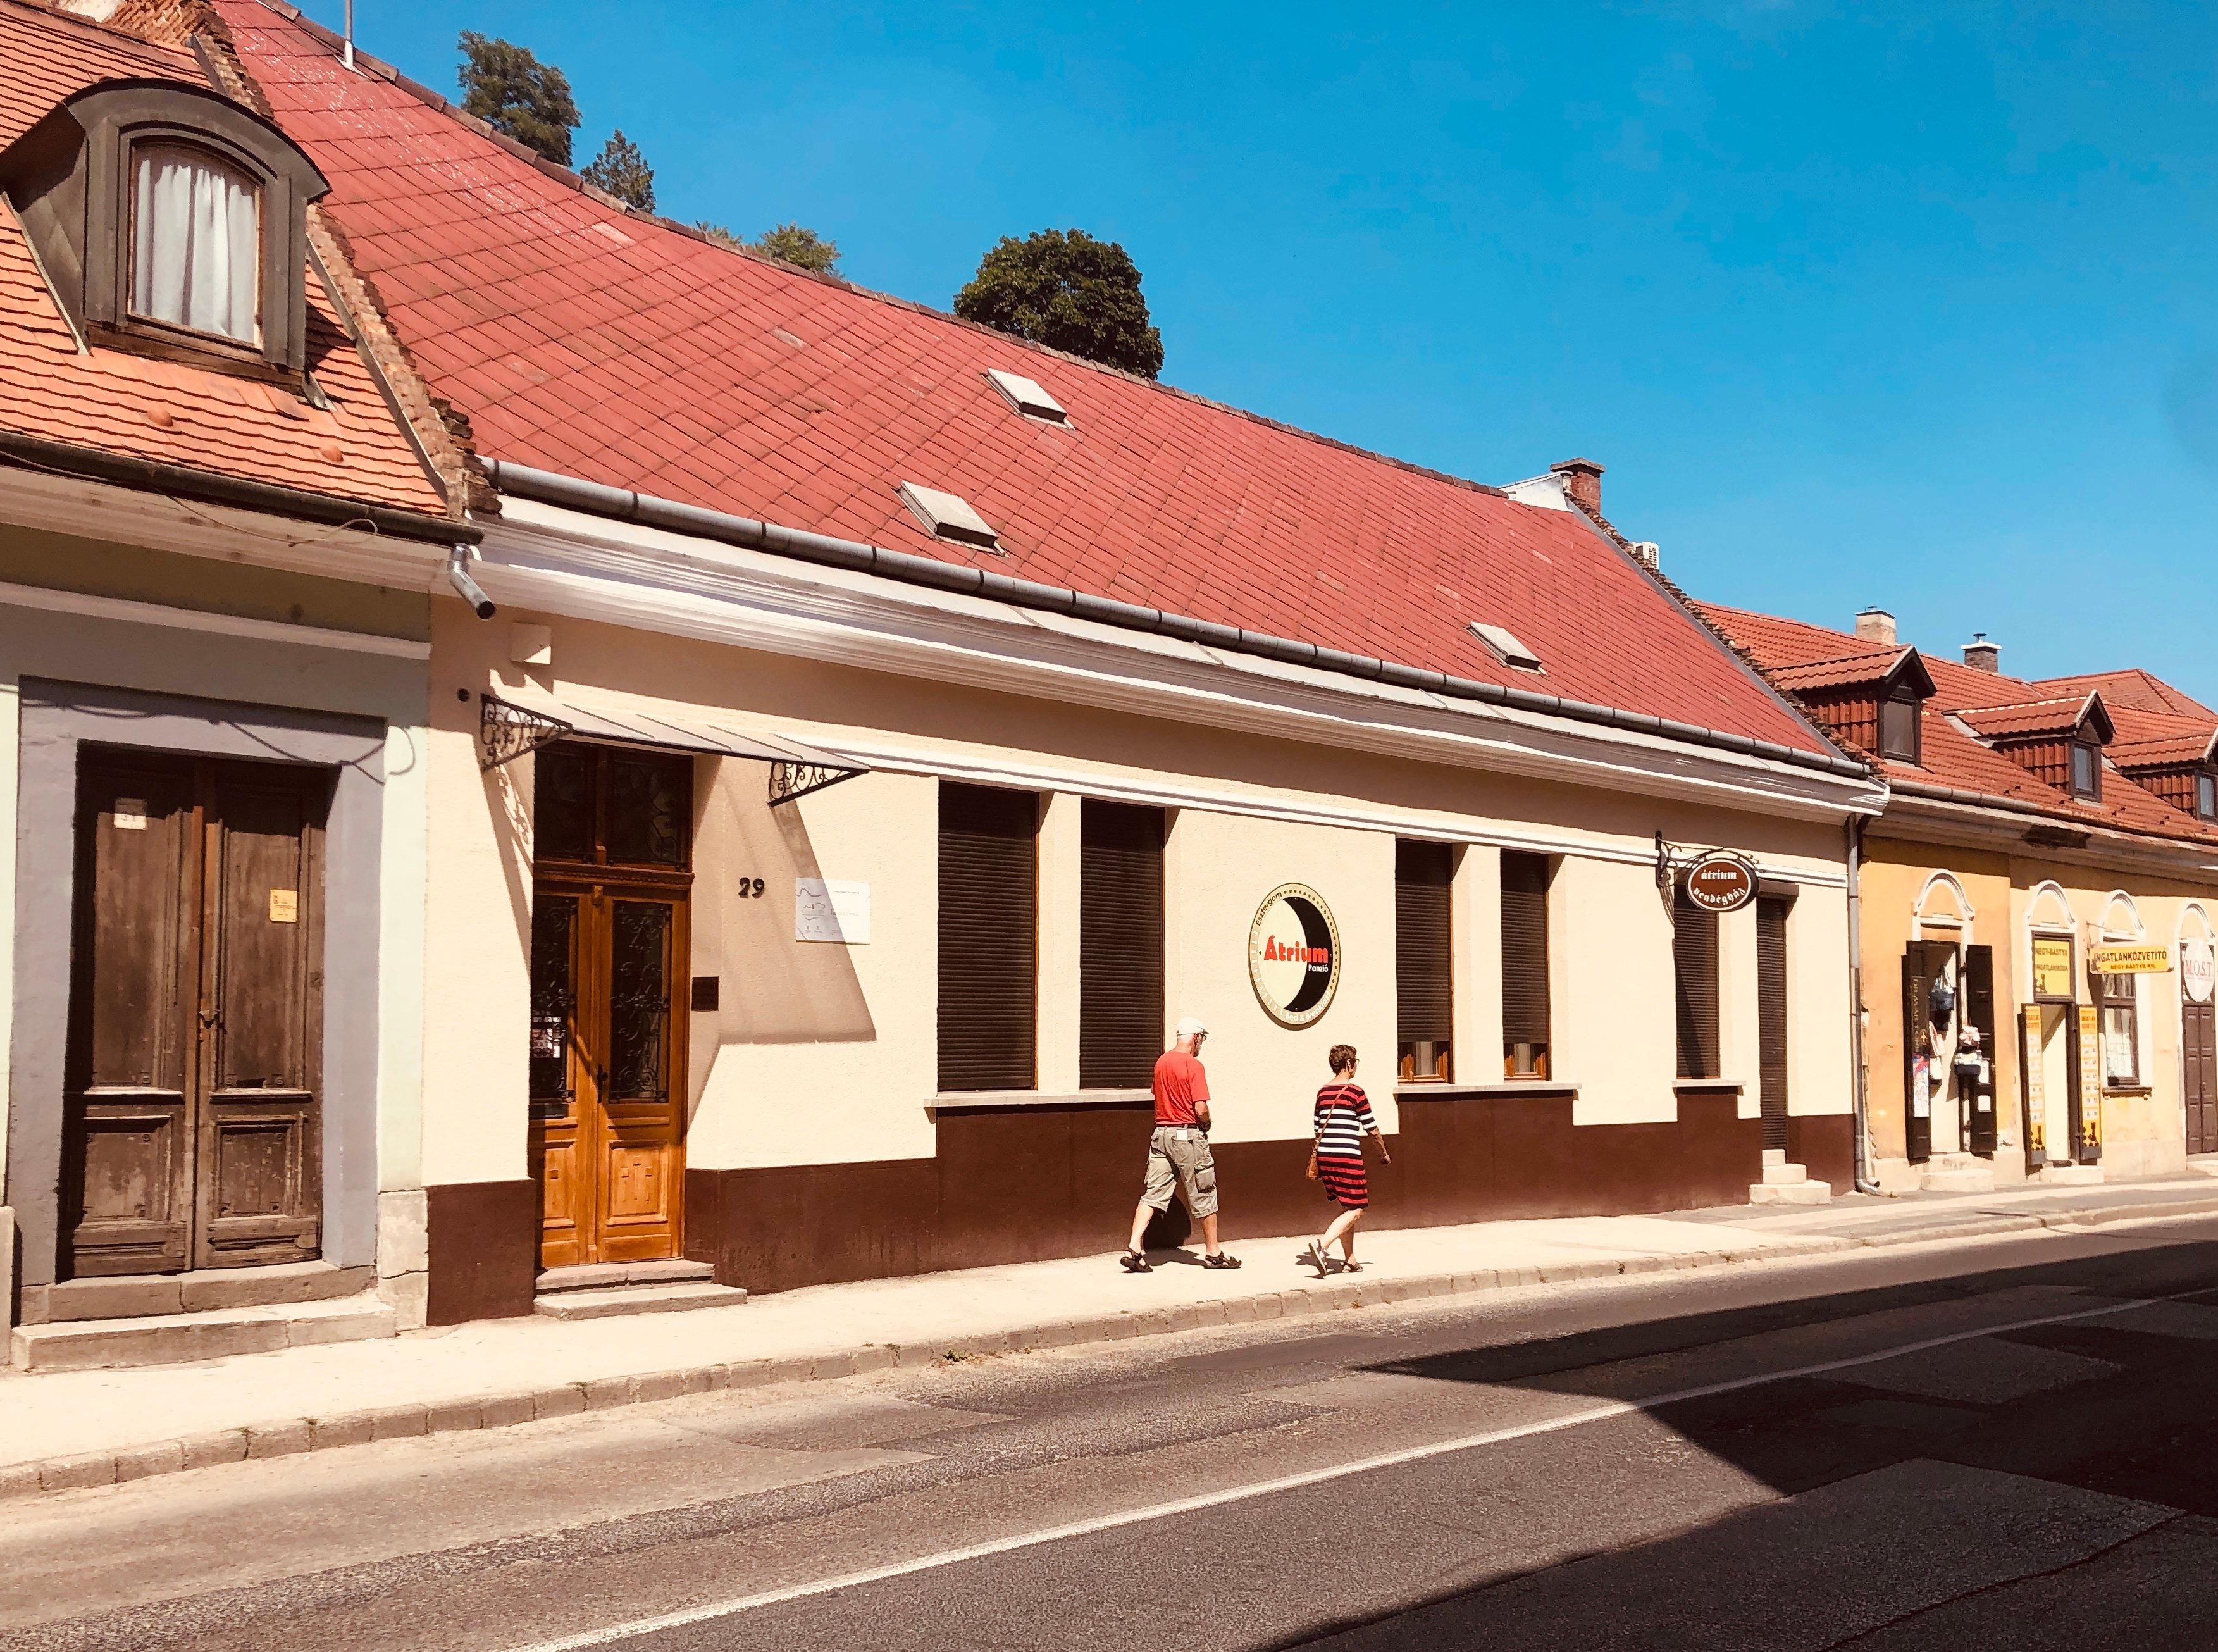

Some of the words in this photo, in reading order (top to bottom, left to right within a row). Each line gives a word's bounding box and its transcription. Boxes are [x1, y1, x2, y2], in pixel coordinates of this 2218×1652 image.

[738, 876, 765, 899] 29
[1255, 891, 1282, 926] Esztergom
[1263, 934, 1329, 964] Átrium
[1308, 964, 1329, 972] Panzió
[1285, 1012, 1298, 1022] Bed
[1299, 1014, 1304, 1022] &
[1305, 991, 1331, 1020] Breakfast
